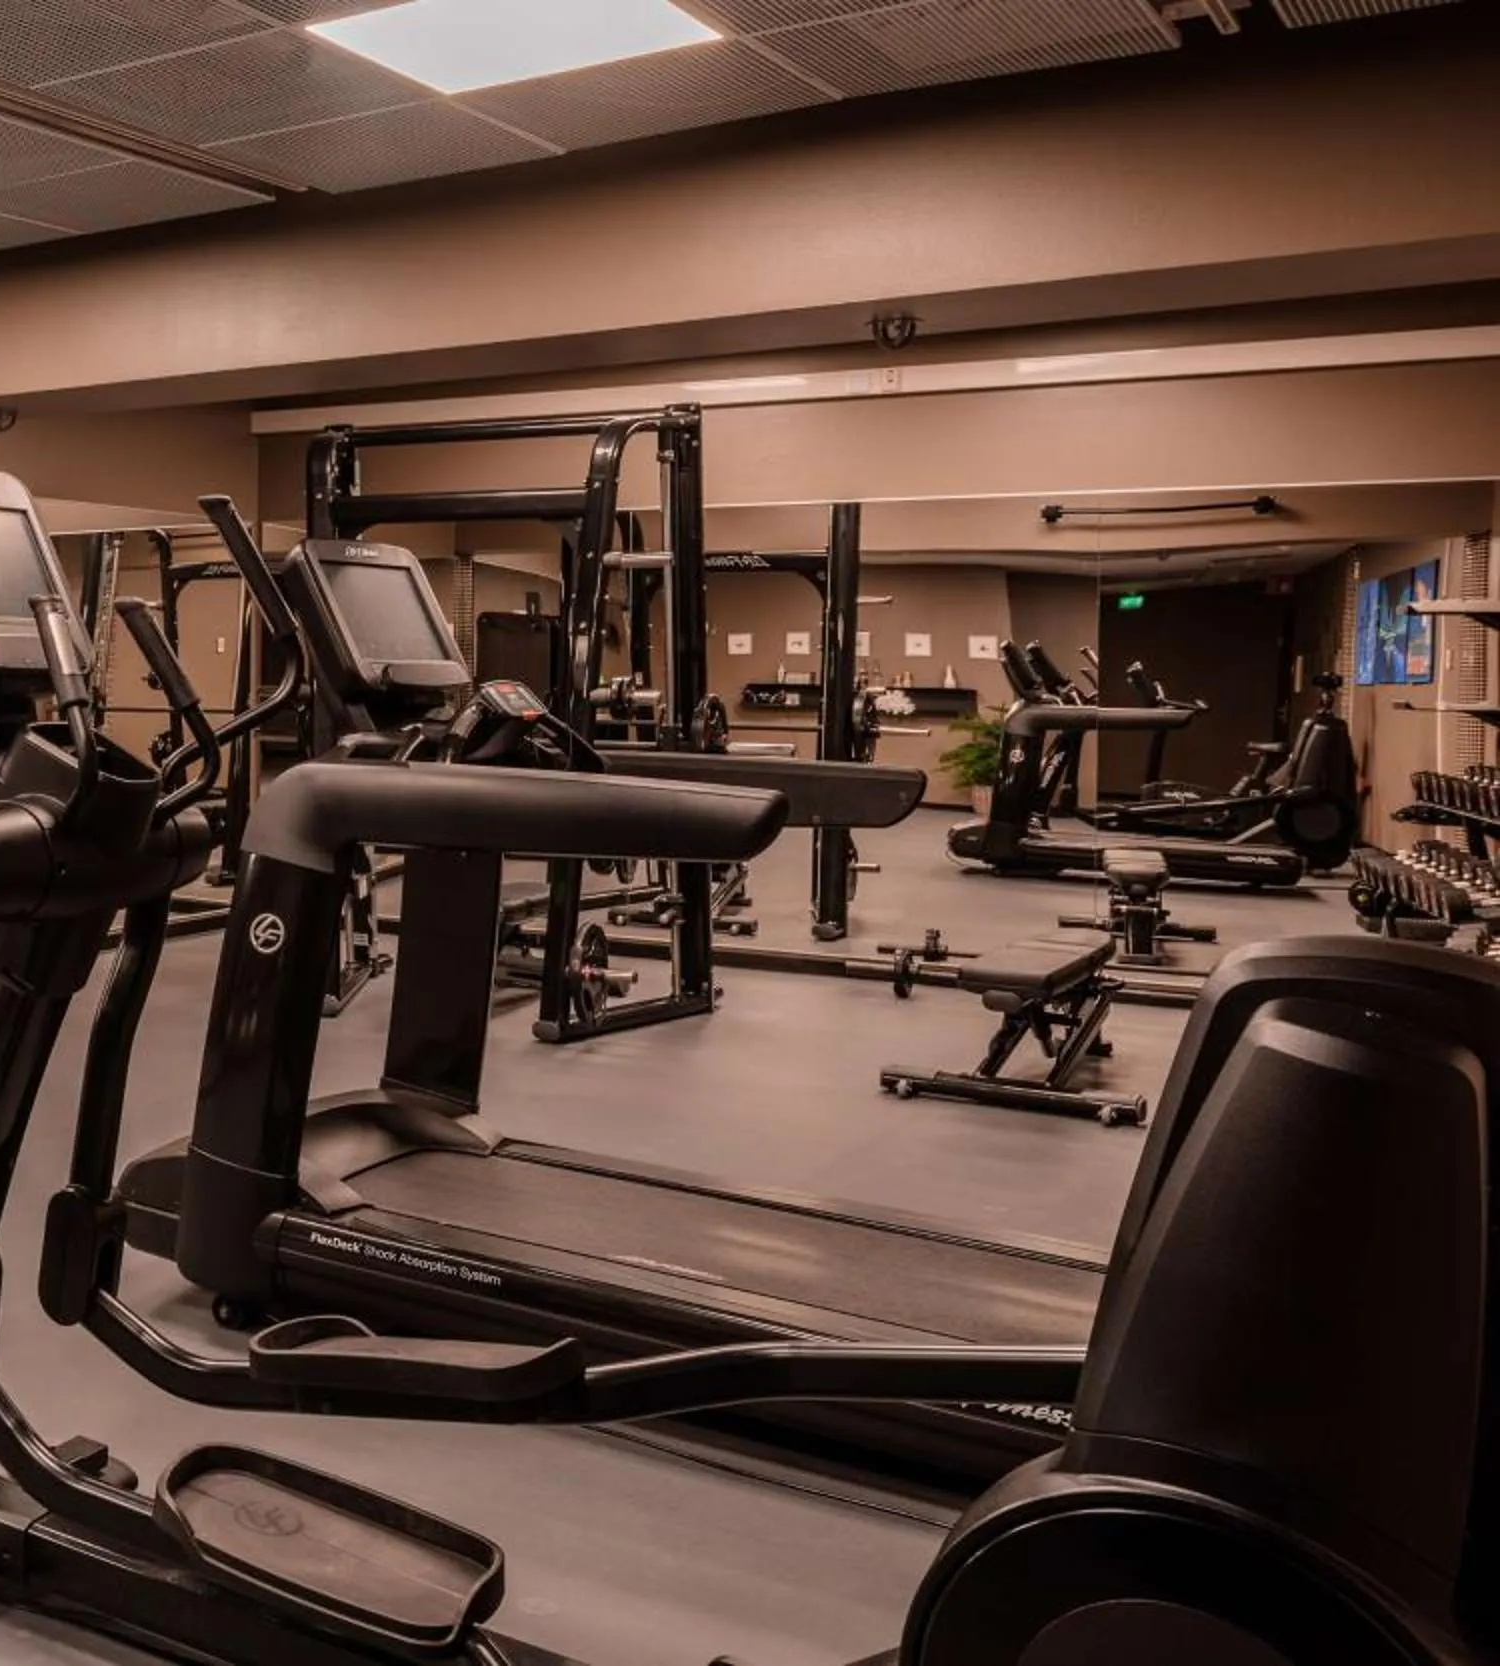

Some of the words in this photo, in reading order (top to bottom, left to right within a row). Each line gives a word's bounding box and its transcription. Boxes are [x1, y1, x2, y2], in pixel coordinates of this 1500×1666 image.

[363, 1244, 397, 1263] Shock
[399, 1252, 458, 1276] Absorption
[459, 1265, 502, 1287] System
